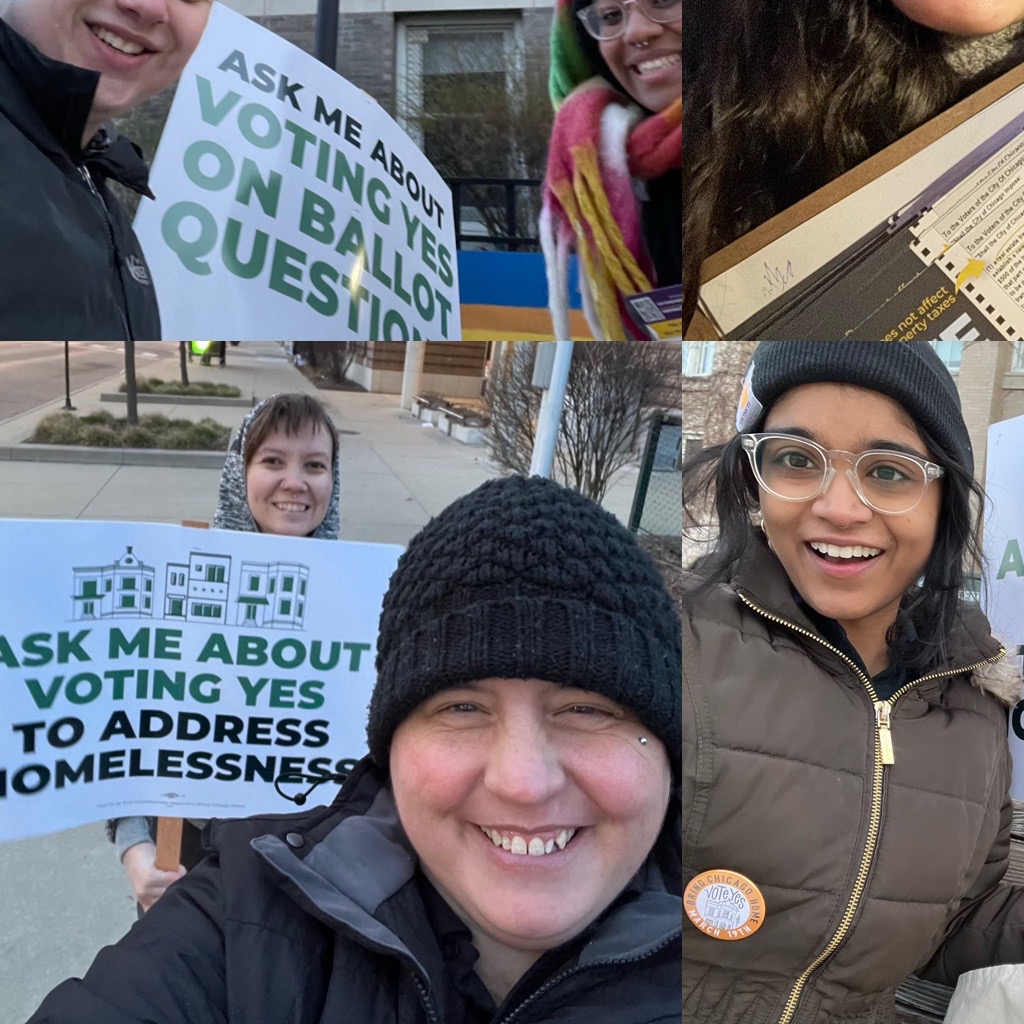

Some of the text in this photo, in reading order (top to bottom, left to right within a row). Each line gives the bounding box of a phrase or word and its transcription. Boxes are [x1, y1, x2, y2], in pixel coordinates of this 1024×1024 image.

[218, 49, 444, 229] ASK ME ABOUT
[195, 74, 453, 288] VOTING YES
[183, 140, 451, 339] ON BALLOT
[161, 201, 429, 341] QUESTIO
[0, 627, 370, 672] ASK ME ABOUT
[24, 669, 325, 710] VOTING YES
[12, 710, 330, 754] TO ADDRESS
[0, 749, 361, 799] OMELESSNESS
[687, 875, 760, 924] BRING CHICAGO HOME
[688, 910, 751, 937] MARCH 19TH
